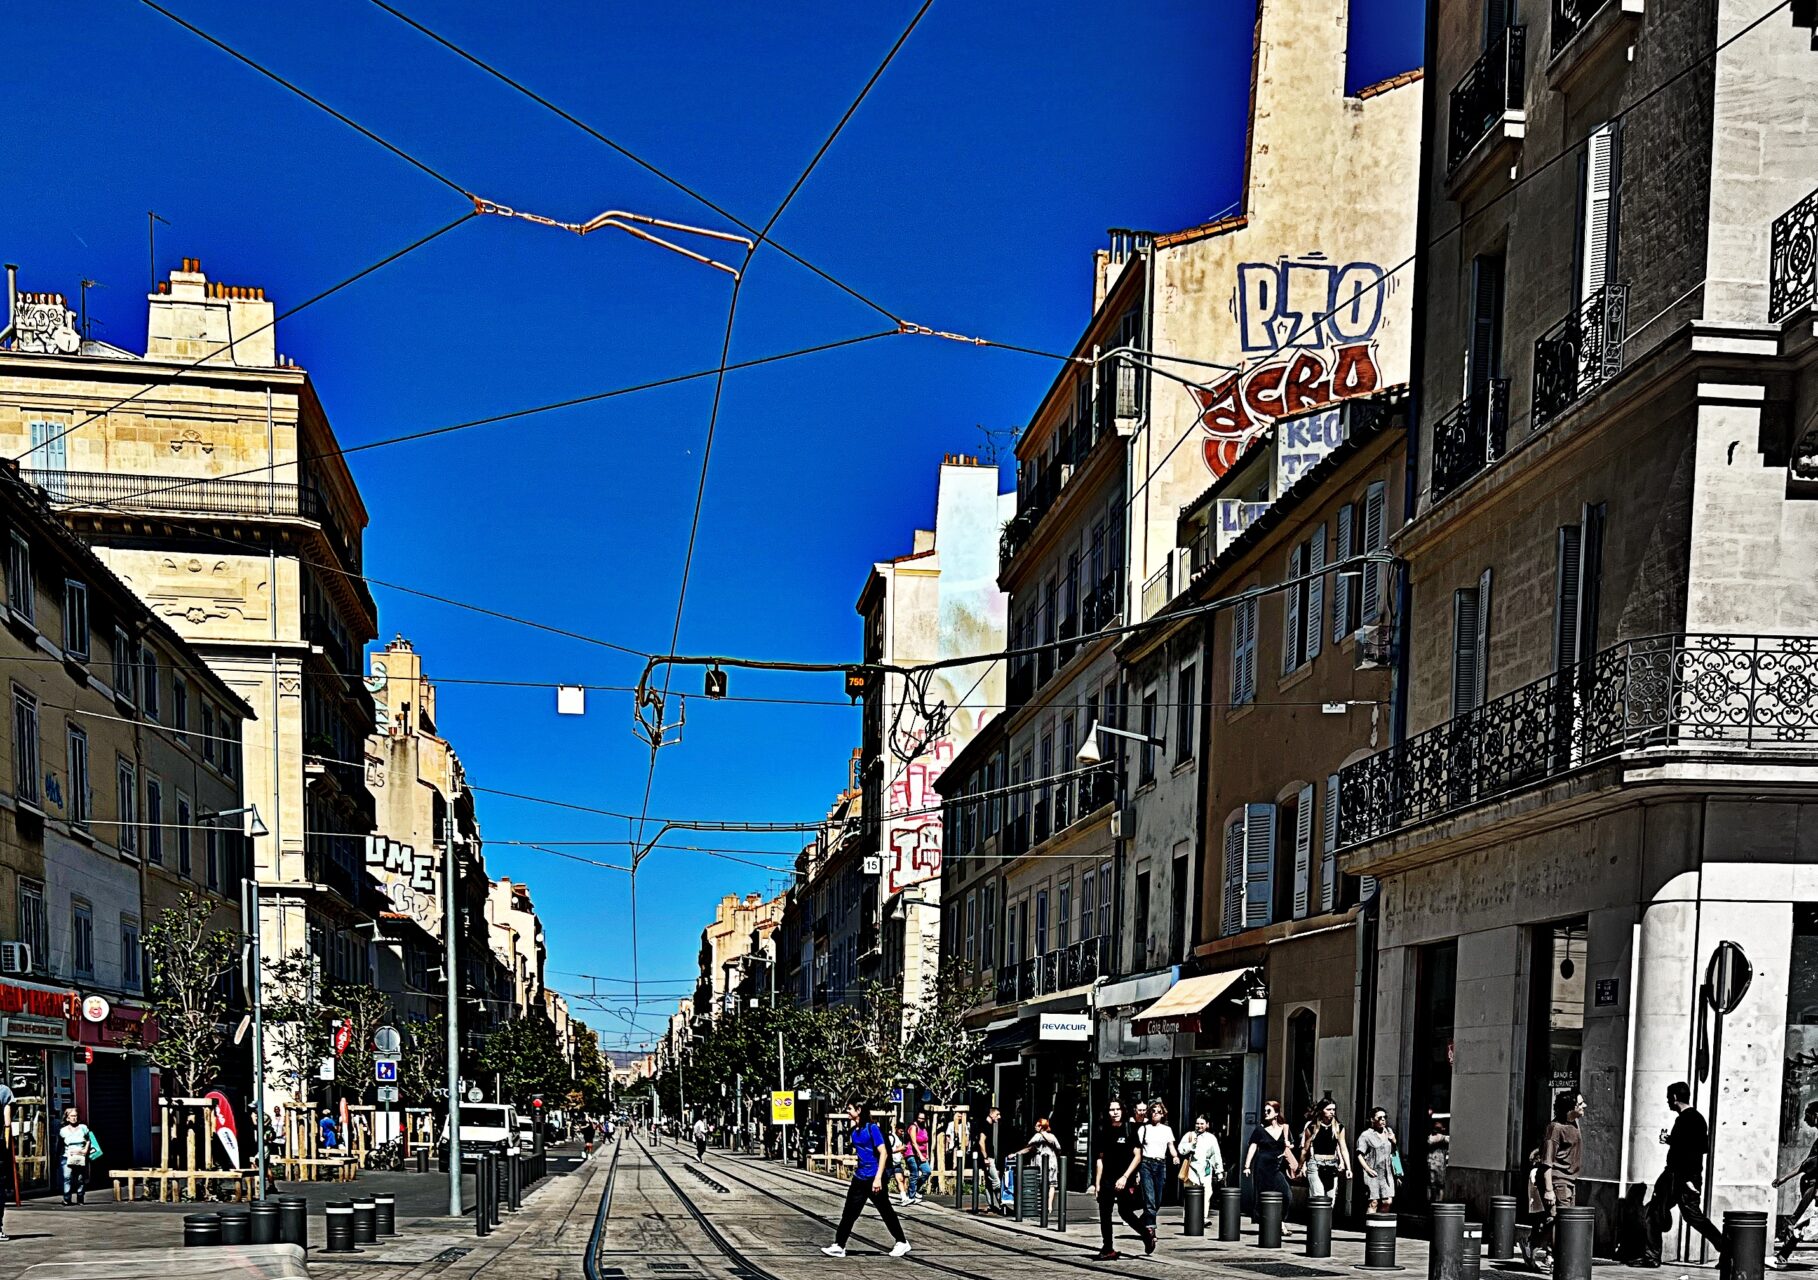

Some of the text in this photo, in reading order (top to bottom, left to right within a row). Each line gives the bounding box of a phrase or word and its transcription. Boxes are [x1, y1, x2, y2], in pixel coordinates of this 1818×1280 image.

[848, 677, 865, 686] 750
[866, 860, 878, 870] 15
[1042, 1023, 1087, 1031] REVACUIR
[1553, 1071, 1573, 1079] BANQE
